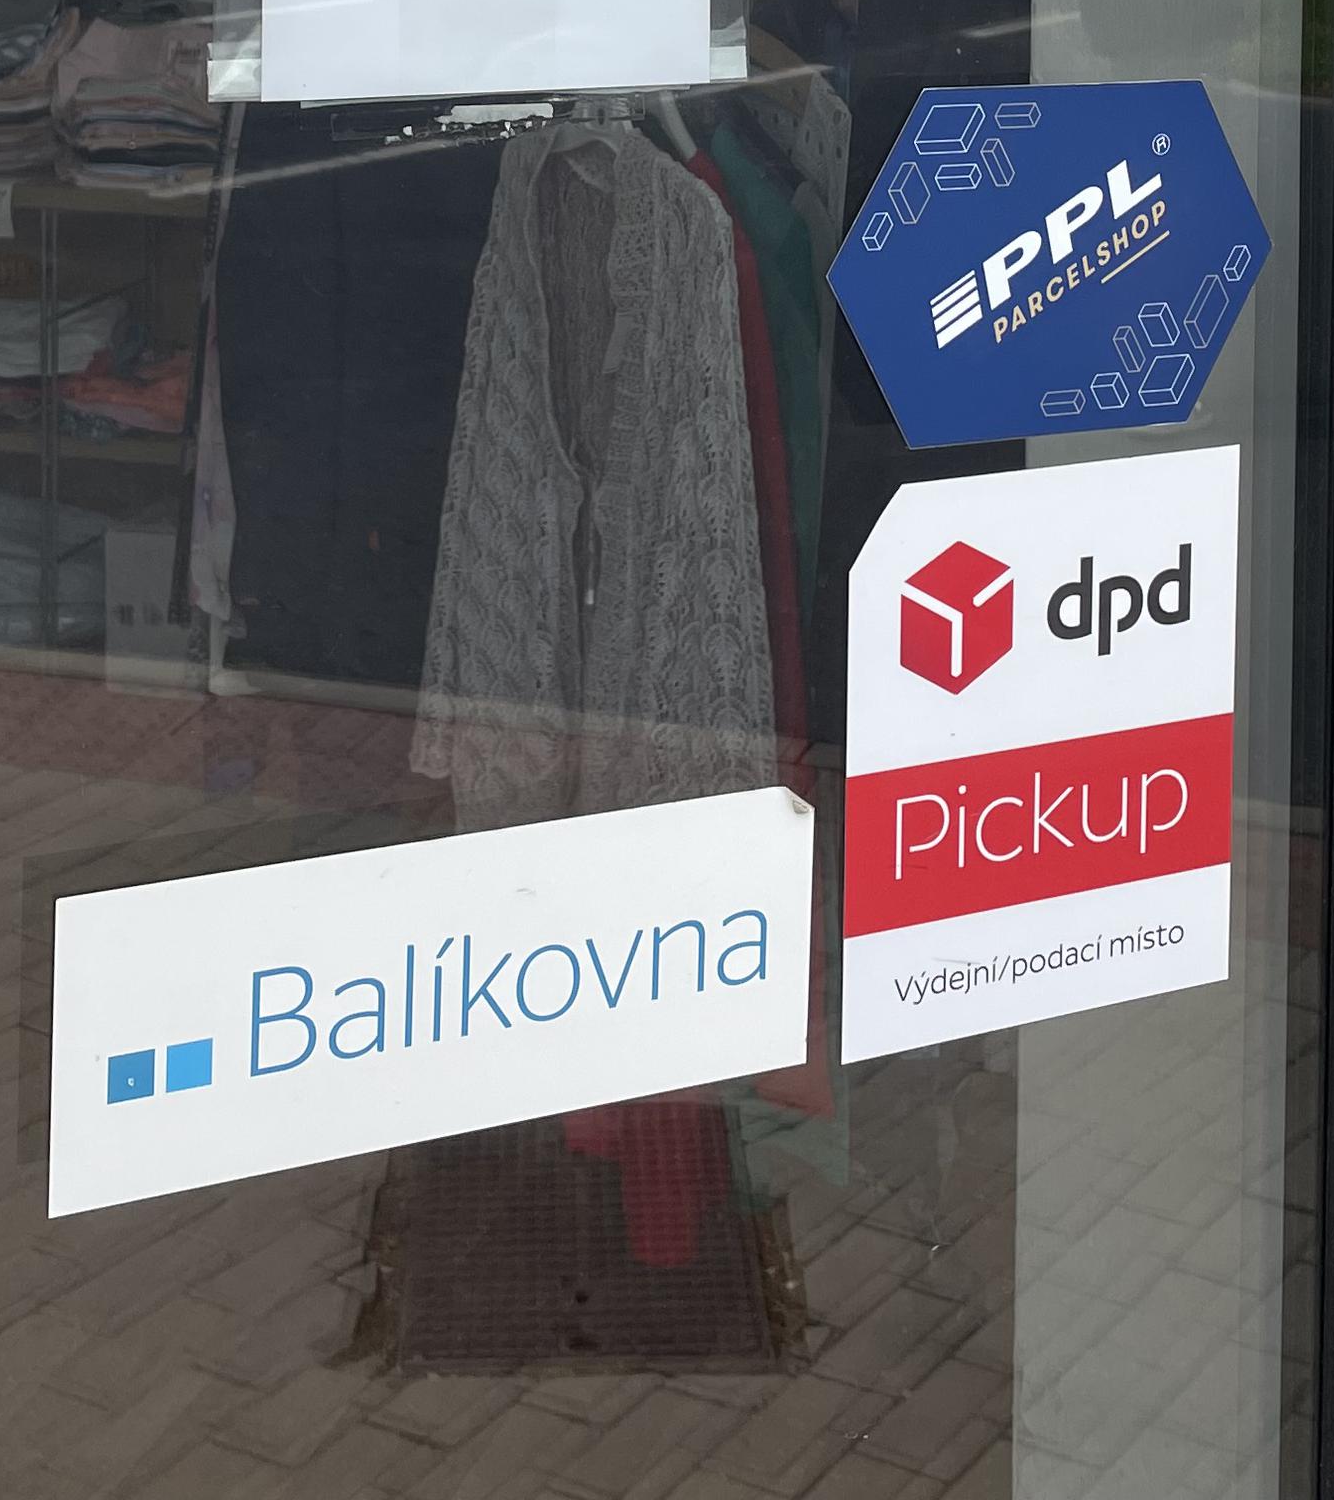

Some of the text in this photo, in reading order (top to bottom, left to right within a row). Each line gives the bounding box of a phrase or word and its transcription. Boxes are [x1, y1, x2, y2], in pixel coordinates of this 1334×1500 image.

[982, 159, 1163, 311] PPL
[992, 199, 1167, 344] PARCELSHOP
[1046, 542, 1192, 657] dpd
[893, 767, 1189, 881] Pickup
[249, 907, 770, 1079] Balíkovna
[893, 924, 1186, 1006] Výdejní/podací místo
